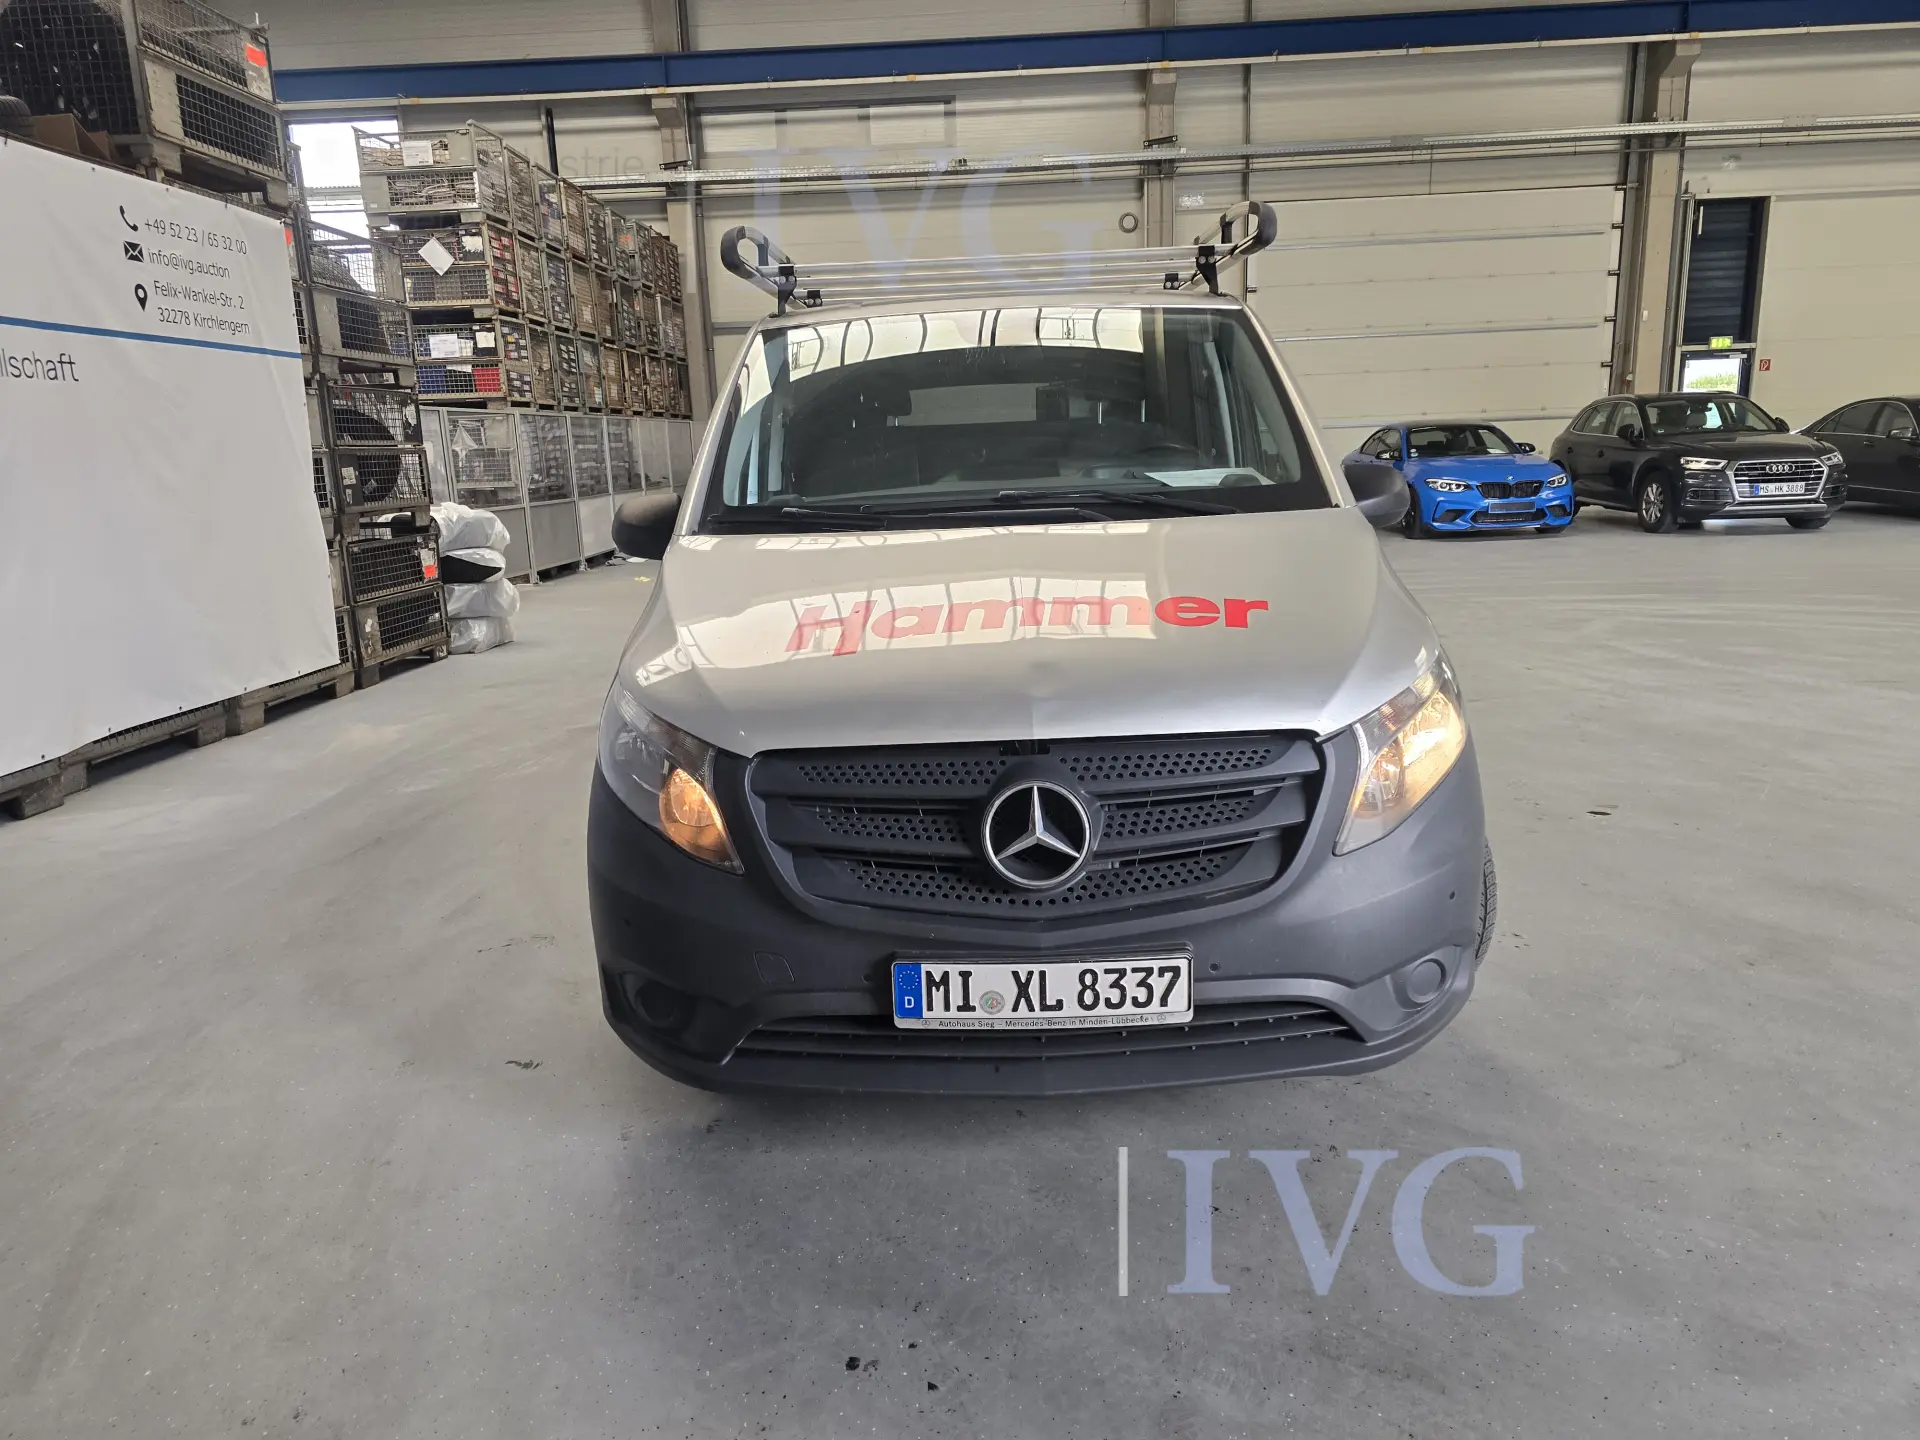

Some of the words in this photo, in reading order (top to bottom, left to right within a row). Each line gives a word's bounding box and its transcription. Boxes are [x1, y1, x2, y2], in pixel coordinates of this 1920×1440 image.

[145, 219, 166, 235] +49
[170, 222, 182, 239] 52
[185, 226, 198, 242] 23
[208, 232, 219, 248] 65
[221, 235, 233, 251] 32
[236, 239, 247, 255] 00
[148, 248, 231, 279] info@ivg.auction
[154, 280, 236, 308] Felix-Wankel-Str.
[238, 296, 245, 310] 2
[157, 307, 191, 326] 32278
[193, 312, 251, 335] Kirchlengern
[784, 596, 1269, 656] Hammer
[904, 996, 914, 1009] D
[925, 970, 977, 1013] MI
[1011, 970, 1064, 1013] XL
[1077, 965, 1182, 1013] 8337
[938, 1020, 975, 1028] Autohaus
[978, 1020, 995, 1029] Sieg
[1005, 1019, 1067, 1028] Mercedes-Benz
[1069, 1018, 1077, 1026] in
[1079, 1016, 1149, 1026] Minden-Lübbecke
